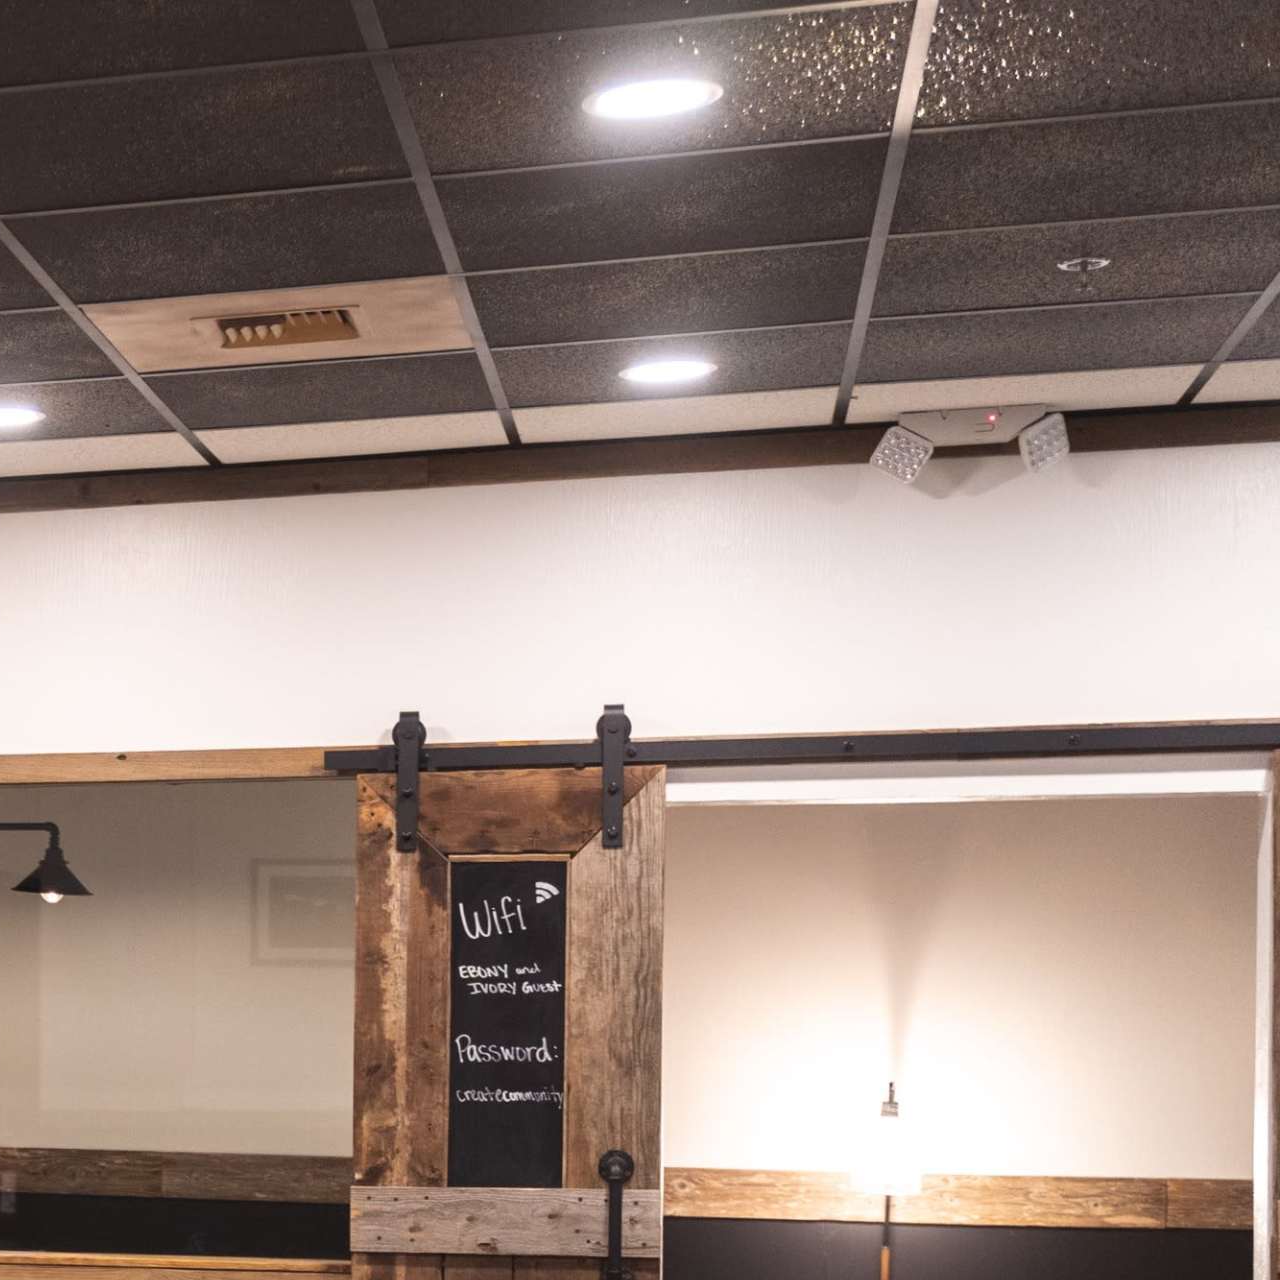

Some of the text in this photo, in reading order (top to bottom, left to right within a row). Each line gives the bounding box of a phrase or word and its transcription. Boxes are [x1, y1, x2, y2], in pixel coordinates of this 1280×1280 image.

[458, 895, 527, 939] Wifi
[458, 961, 542, 979] EBONY and
[466, 981, 517, 996] IVORY
[455, 1033, 560, 1063] Password:
